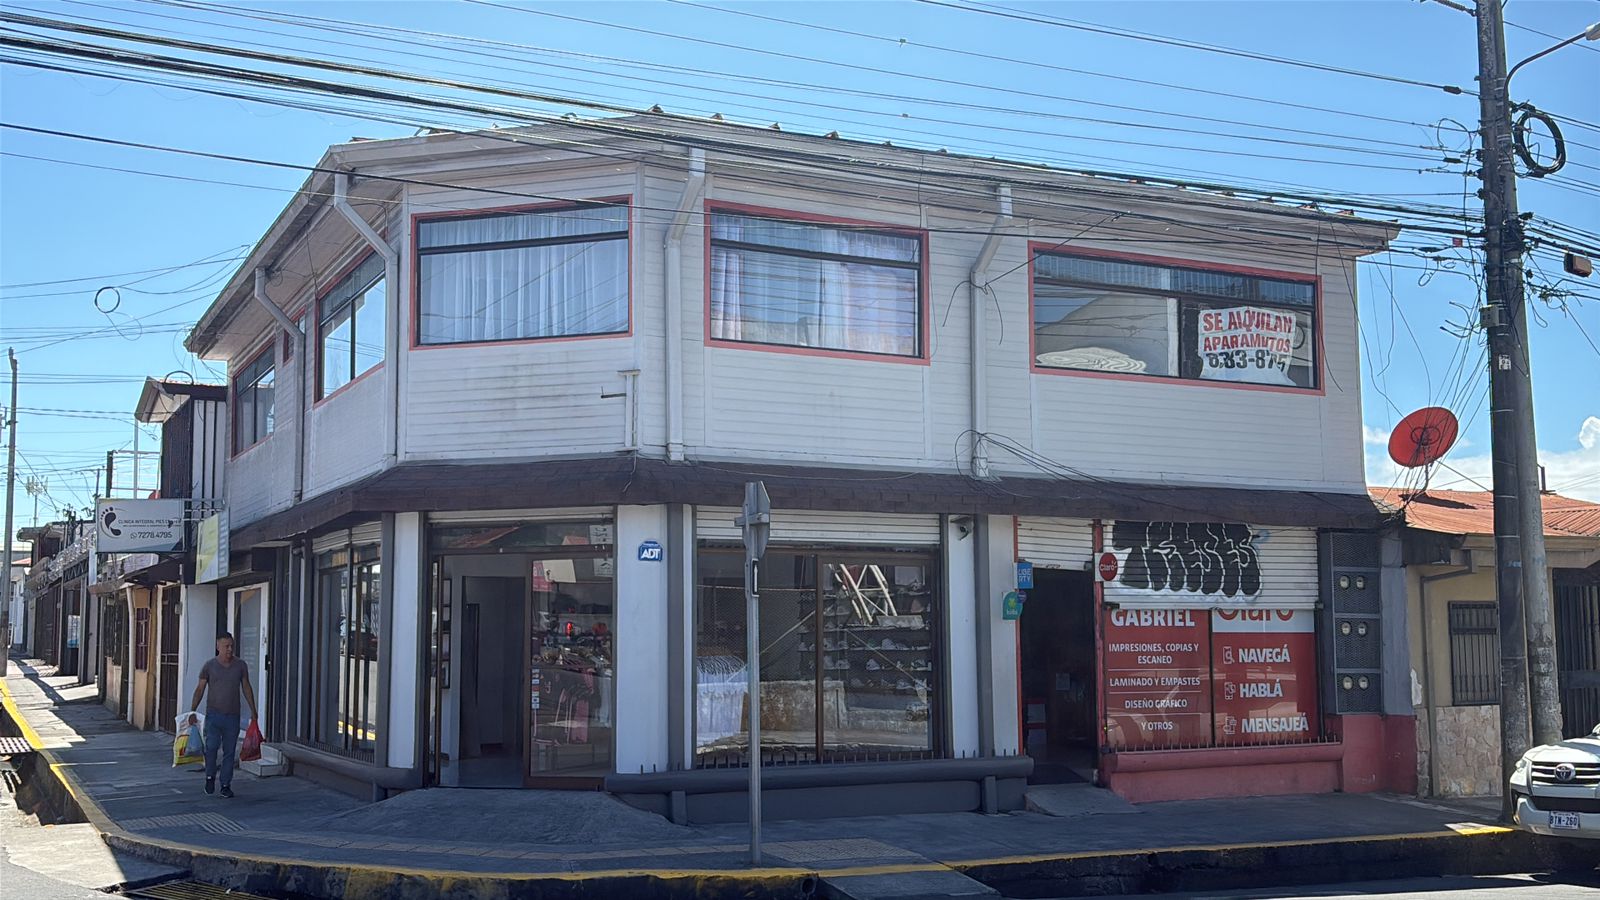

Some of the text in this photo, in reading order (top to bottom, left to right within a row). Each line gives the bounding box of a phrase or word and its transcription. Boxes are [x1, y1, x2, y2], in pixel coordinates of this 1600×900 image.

[1203, 313, 1223, 331] SE
[641, 548, 660, 559] ADT
[1100, 563, 1114, 572] Claro
[1111, 609, 1195, 627] GABRIEL
[1109, 643, 1199, 654] IMPRESIONES, COPIAS Y
[1238, 644, 1291, 663] NAVEGÁ
[1138, 655, 1172, 664] ESCANEO
[1110, 676, 1200, 686] LAMINADO Y EMPASTES
[1239, 678, 1283, 698] HABLÁ
[1124, 697, 1187, 708] DISEÑO GRÁFICO
[1142, 721, 1173, 730] Y OTROS
[1242, 713, 1309, 734] MENSAJEÁ
